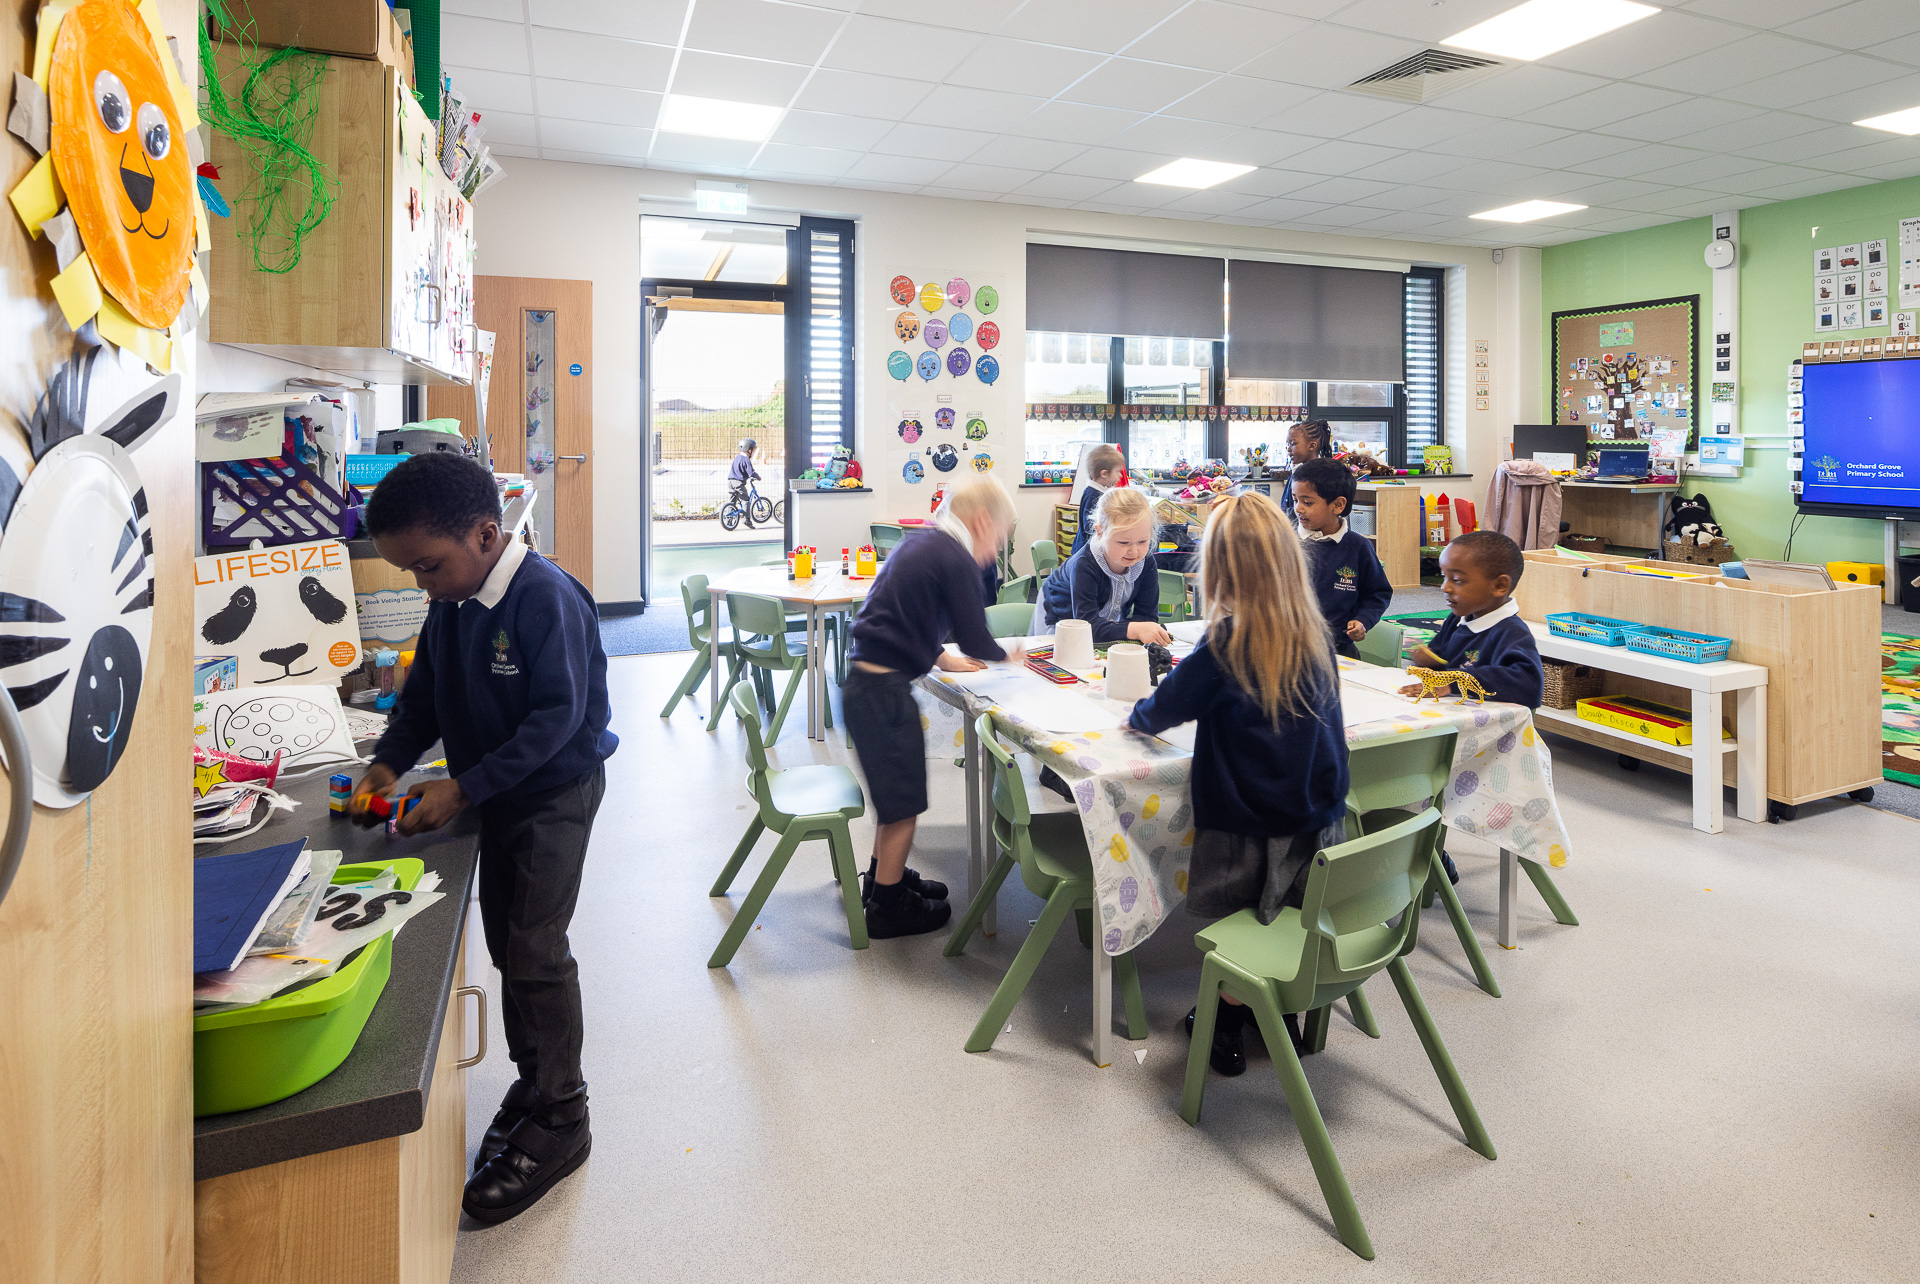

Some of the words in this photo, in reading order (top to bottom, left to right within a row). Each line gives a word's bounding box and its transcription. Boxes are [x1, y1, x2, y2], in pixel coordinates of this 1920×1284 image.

[1867, 241, 1882, 251] igh
[1043, 451, 1048, 459] 2
[1846, 470, 1876, 478] Primary
[194, 544, 342, 586] LIFESIZE
[1580, 706, 1606, 721] Dough
